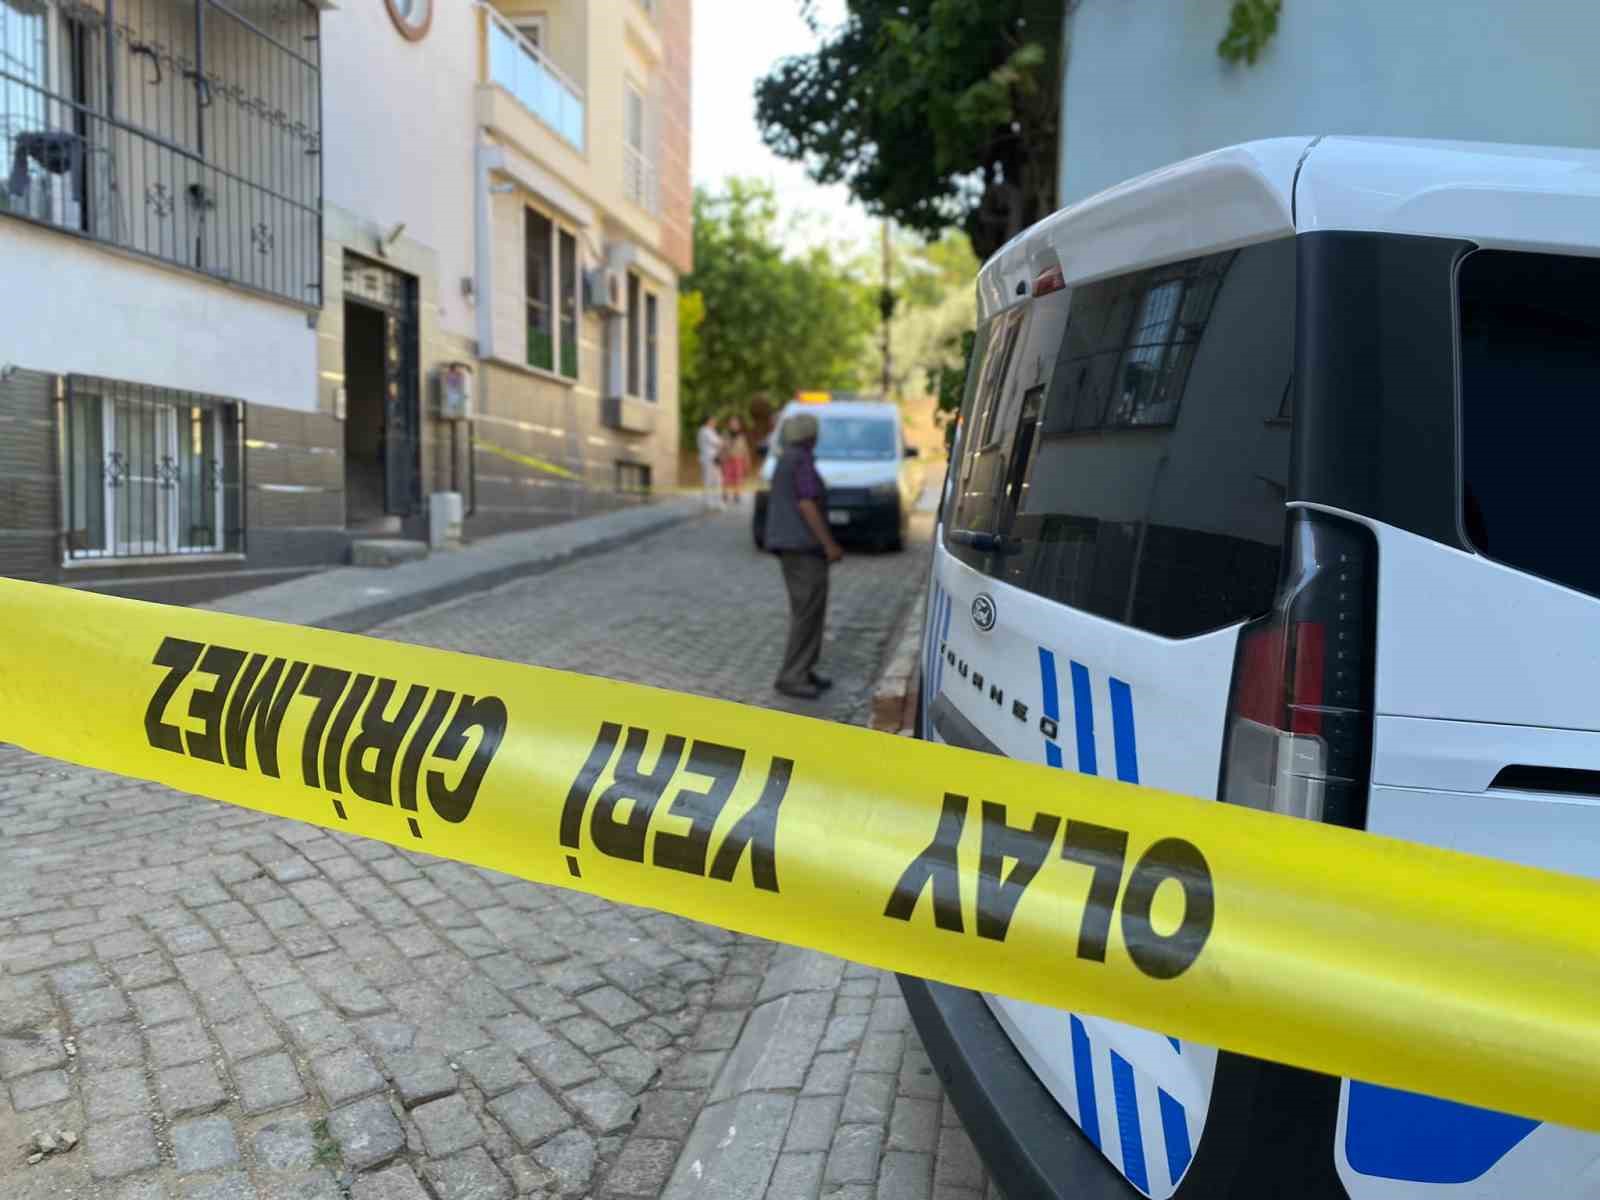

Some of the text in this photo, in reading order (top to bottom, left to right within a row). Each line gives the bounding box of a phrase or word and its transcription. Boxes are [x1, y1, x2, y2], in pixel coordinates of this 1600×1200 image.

[144, 636, 1215, 980] OLAY YERİ GİRİLMEZ
